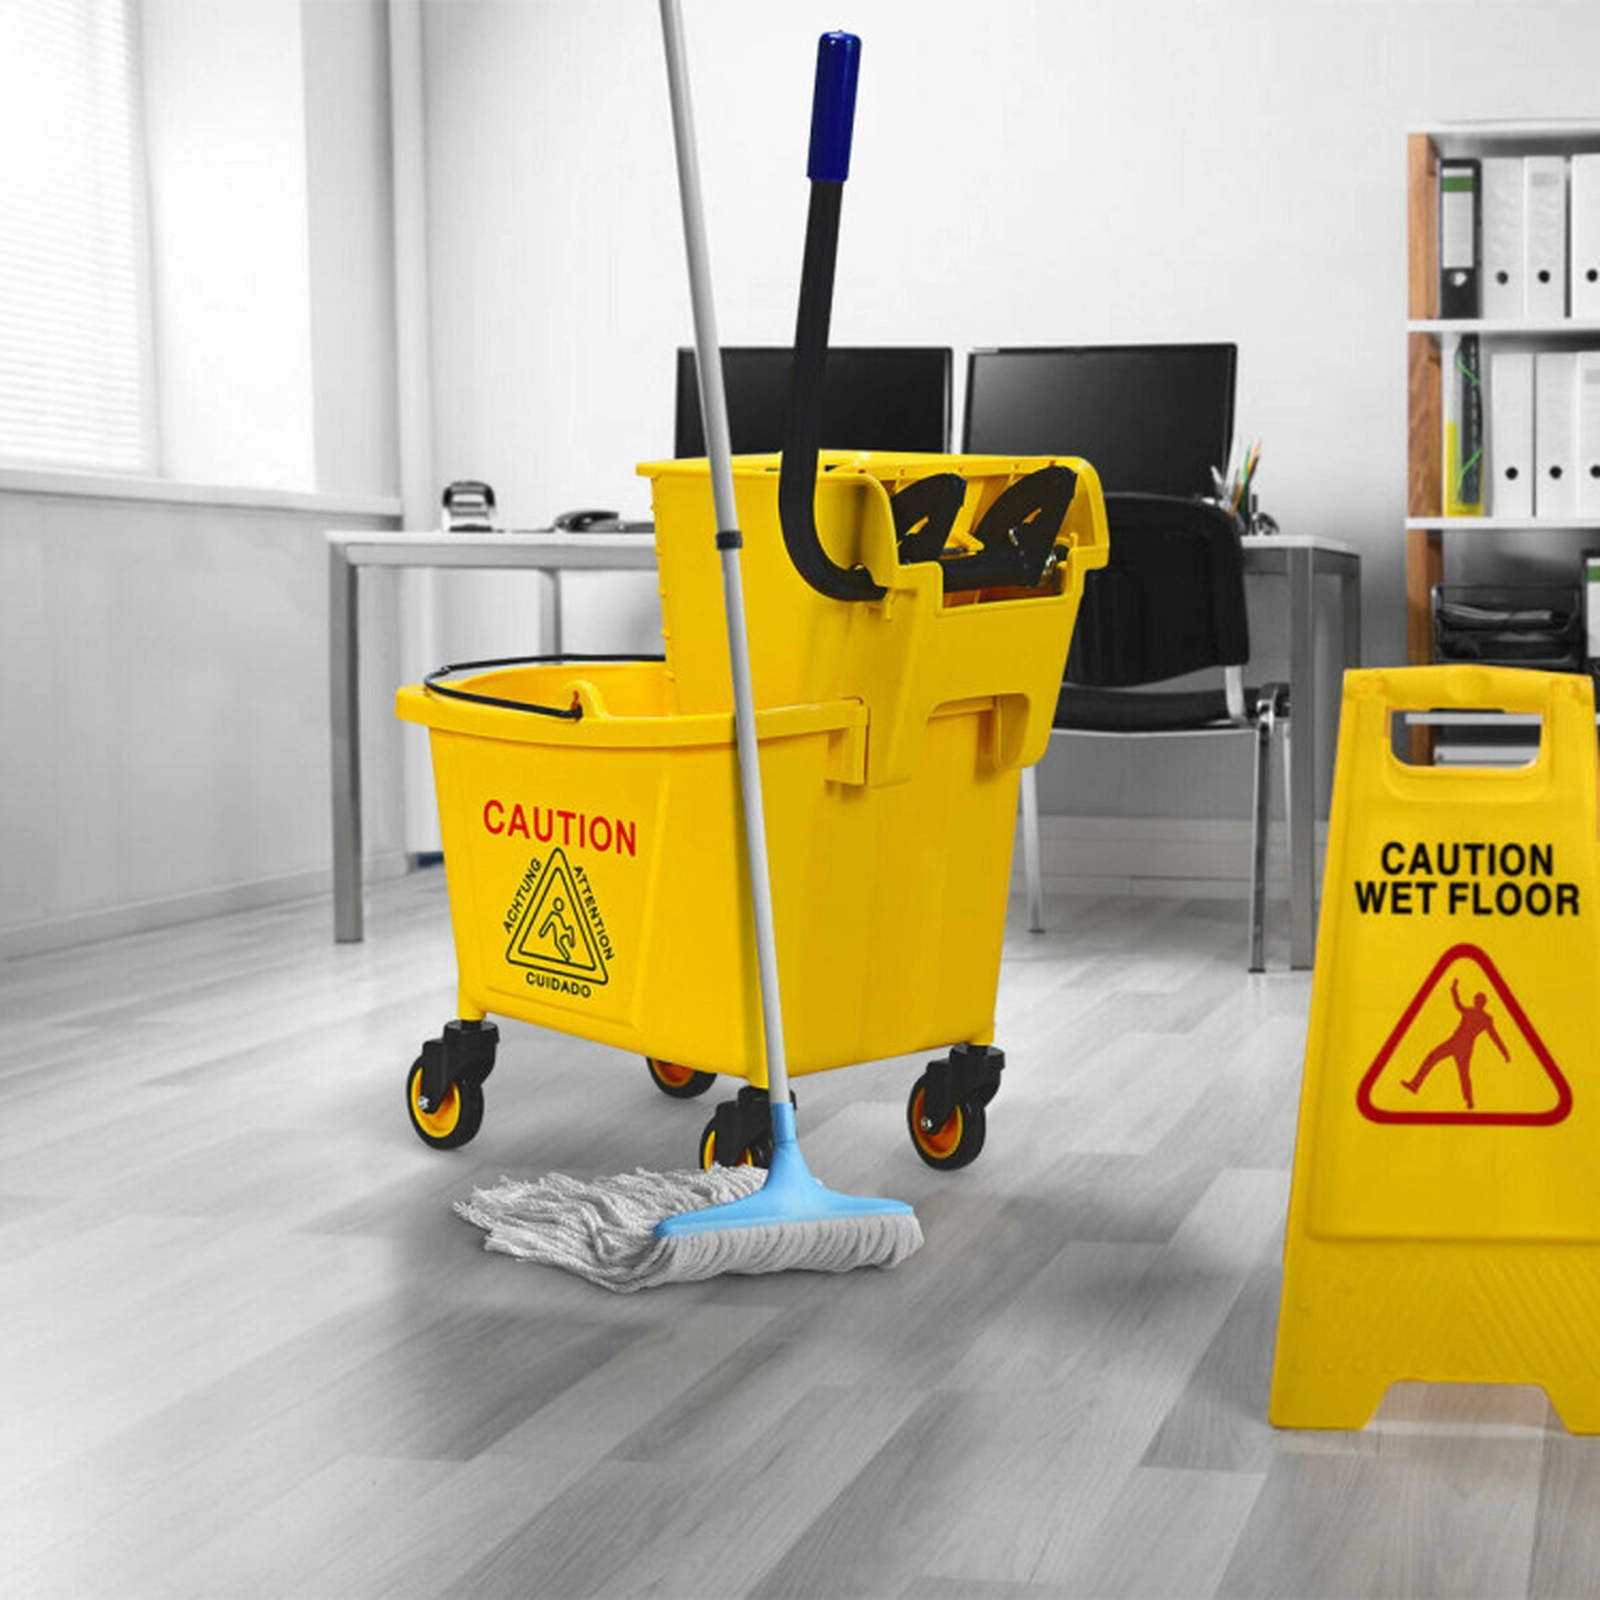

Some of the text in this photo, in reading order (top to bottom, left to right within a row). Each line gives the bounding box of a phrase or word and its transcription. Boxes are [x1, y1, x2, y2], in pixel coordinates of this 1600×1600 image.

[483, 799, 636, 857] CAUTION
[1381, 841, 1553, 876] CAUTION
[502, 858, 541, 934] ACHTUNG
[573, 865, 615, 961] ATTENTION
[1354, 881, 1580, 917] WET FLOOR
[526, 971, 591, 998] CUIDADO
